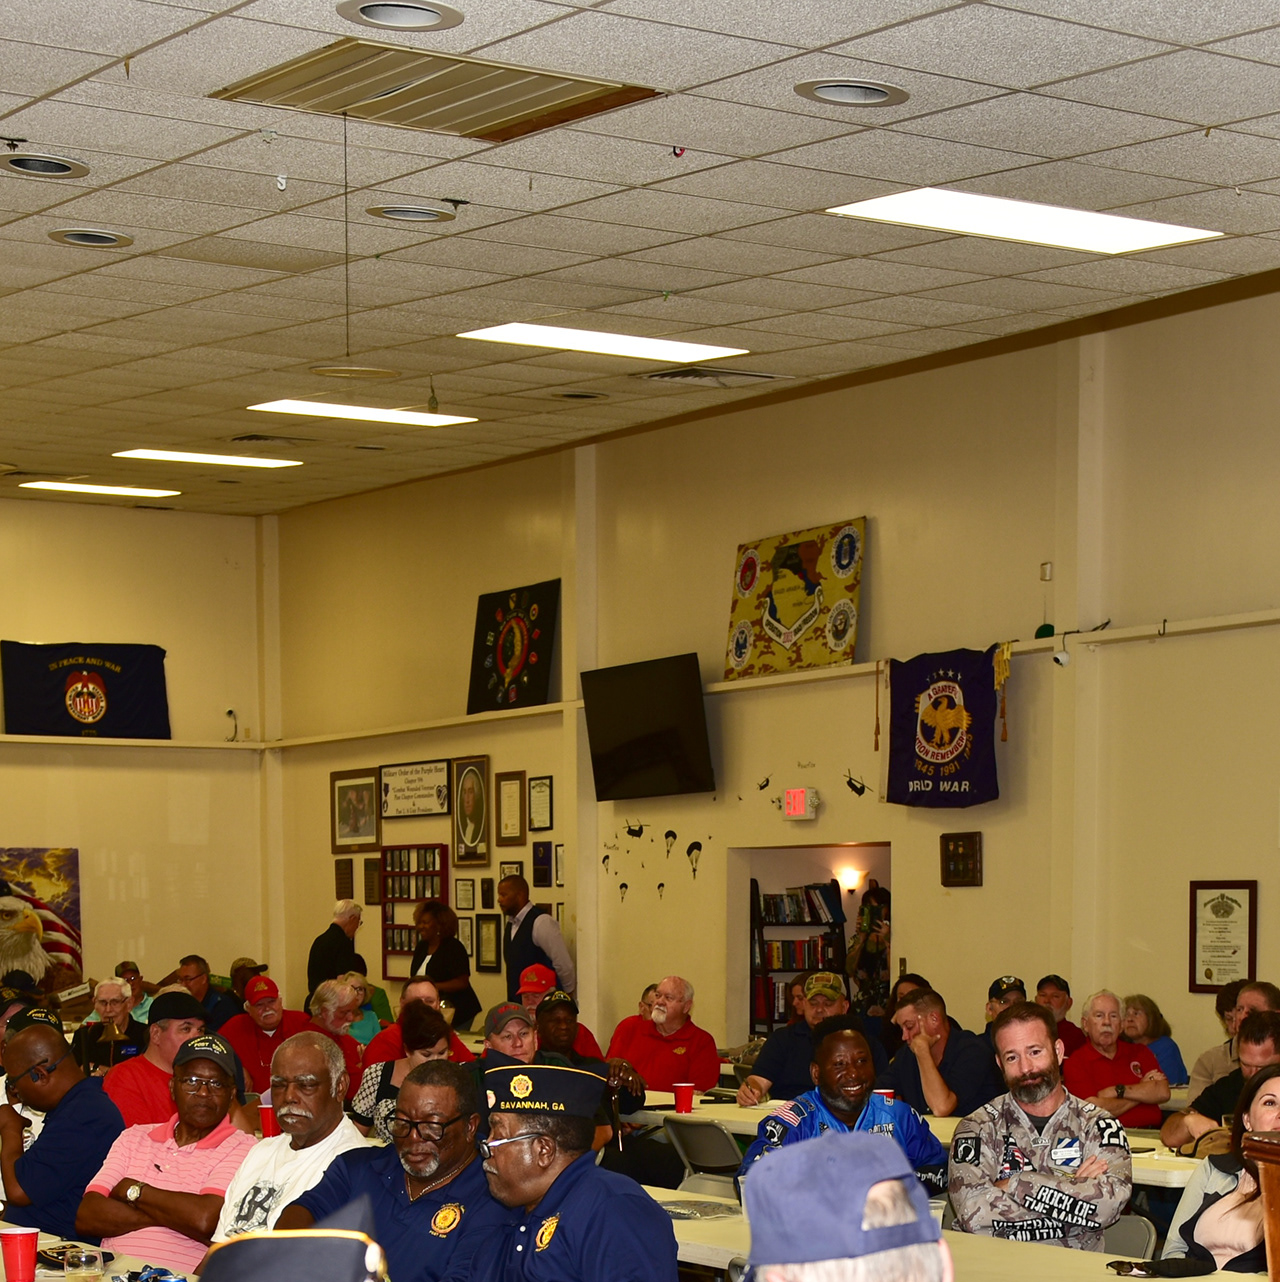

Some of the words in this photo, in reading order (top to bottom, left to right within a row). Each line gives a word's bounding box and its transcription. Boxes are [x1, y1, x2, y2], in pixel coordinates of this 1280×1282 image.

[940, 781, 970, 792] WAR
[785, 788, 806, 816] EXIT
[500, 1101, 550, 1111] SAVANNAH,
[551, 1102, 565, 1111] GA
[1024, 1195, 1050, 1214] THE
[1037, 1186, 1074, 1212] ROCK
[1074, 1200, 1096, 1220] OF
[1008, 1228, 1064, 1241] MILITIA
